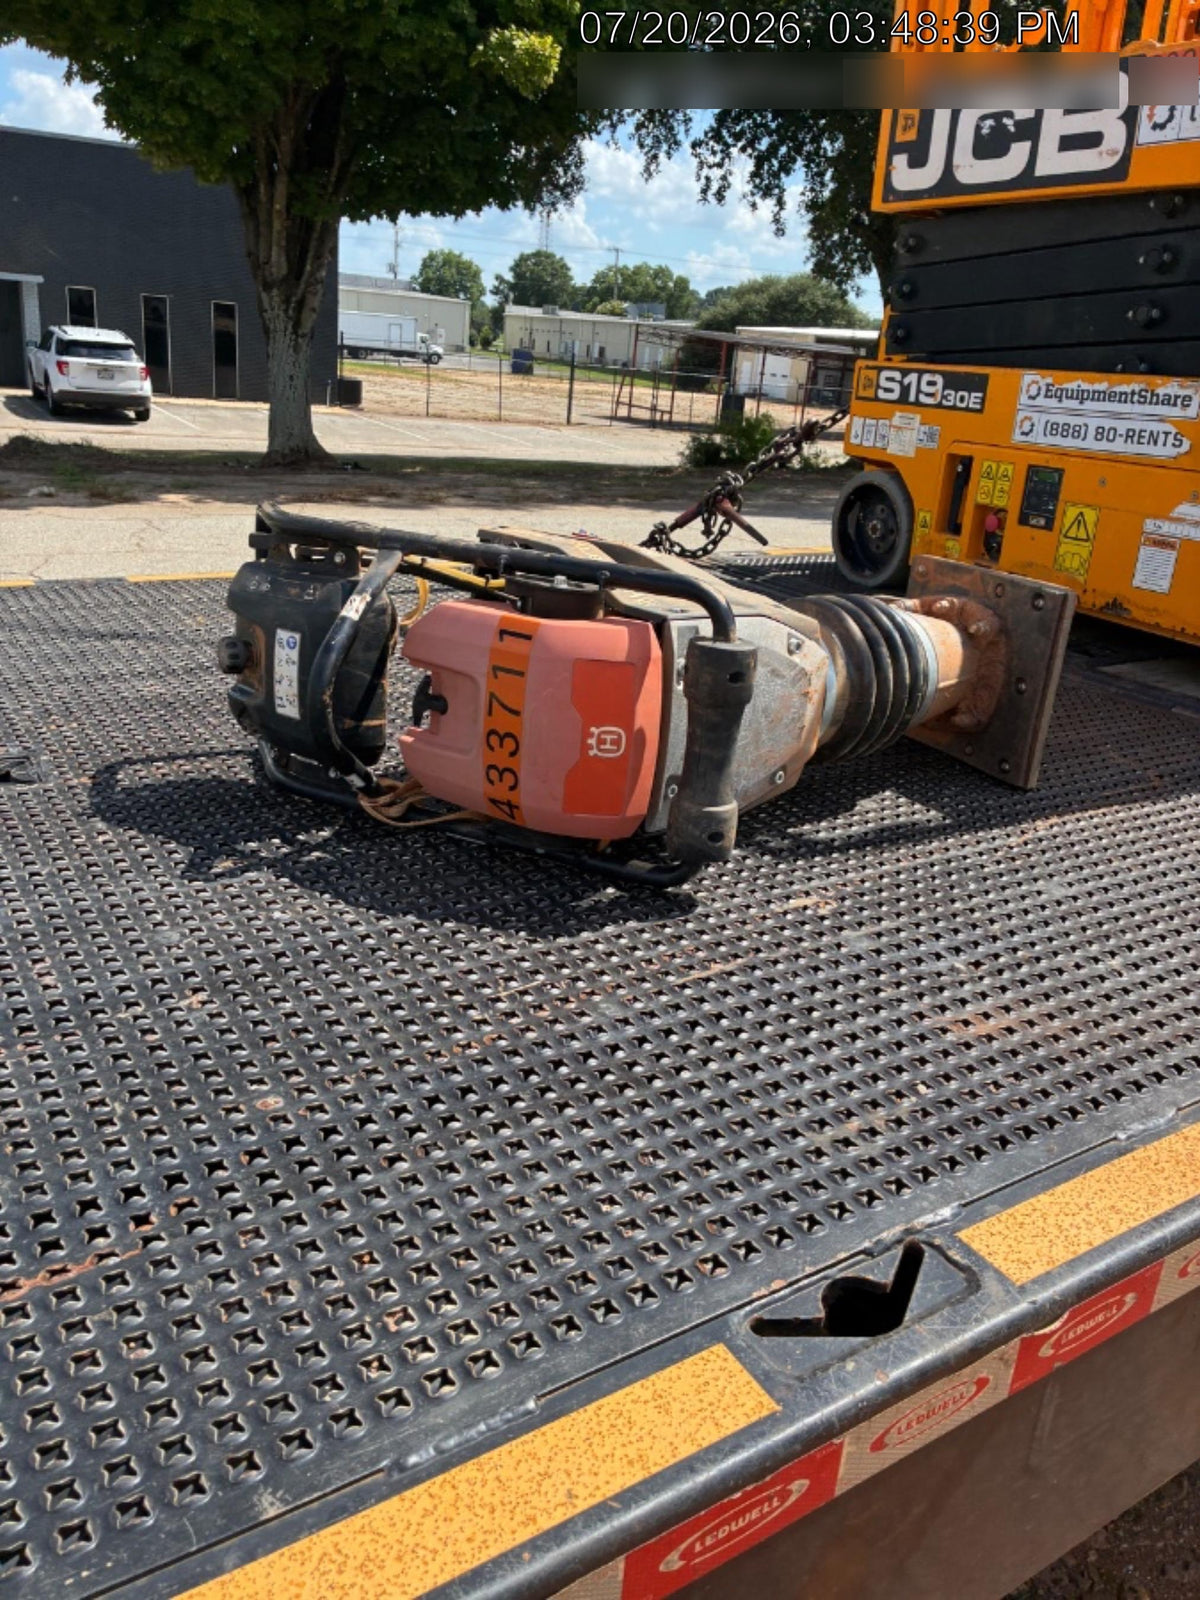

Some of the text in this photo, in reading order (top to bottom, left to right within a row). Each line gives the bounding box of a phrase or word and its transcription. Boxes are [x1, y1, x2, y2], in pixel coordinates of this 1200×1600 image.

[890, 71, 1129, 191] JCB
[1043, 383, 1193, 408] EquipmentShare
[1043, 419, 1185, 449] (888) 80-RENTS
[486, 628, 533, 820] 433711
[1061, 1304, 1118, 1345] LEDWELL
[896, 1391, 966, 1436] LEDWELL
[694, 1495, 783, 1553] LEDWELL
